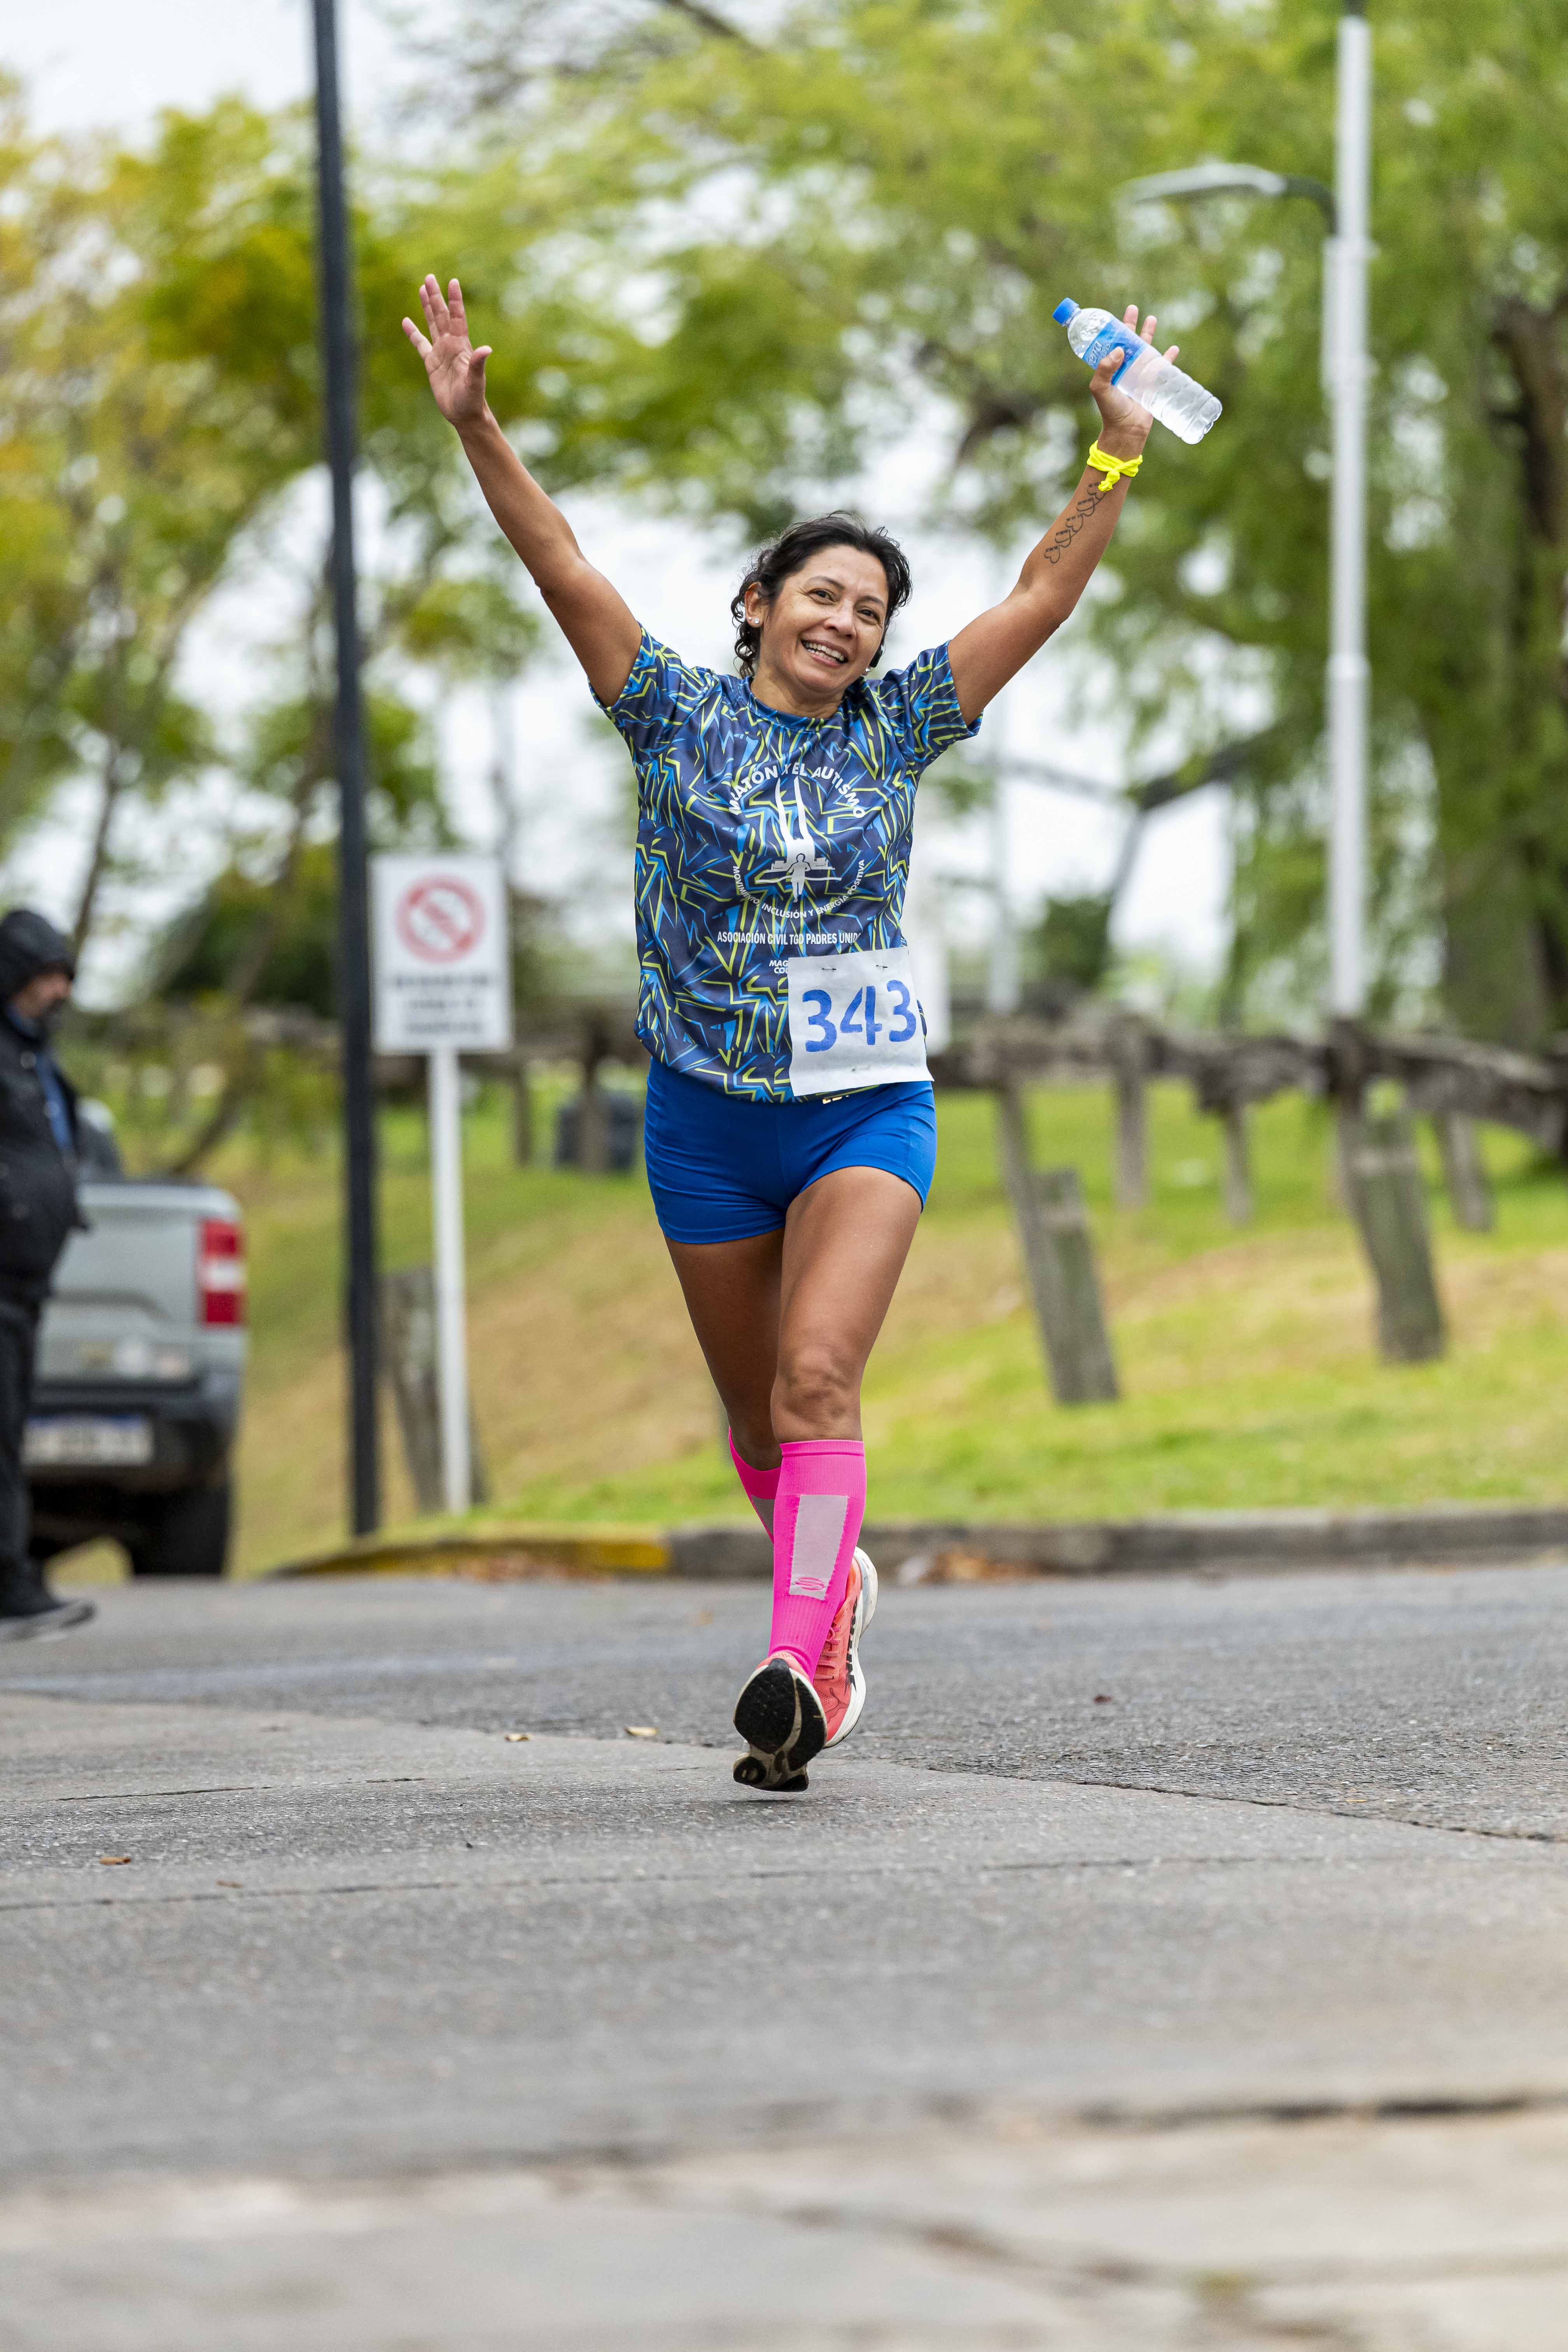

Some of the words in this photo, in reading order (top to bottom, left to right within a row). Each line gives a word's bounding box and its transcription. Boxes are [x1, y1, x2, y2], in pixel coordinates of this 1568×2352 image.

[792, 762, 807, 777] EL
[811, 766, 866, 819] AUTISMO
[761, 903, 807, 919] INCLUSIÓN
[816, 895, 849, 915] ENERGÍA
[847, 859, 865, 895] POSITIVA
[717, 930, 766, 944] ASOCIACIÓN
[767, 933, 788, 945] CIVIL
[789, 933, 804, 945] TGD
[806, 933, 838, 945] PADRES
[839, 933, 861, 944] UNID
[802, 979, 917, 1052] 343
